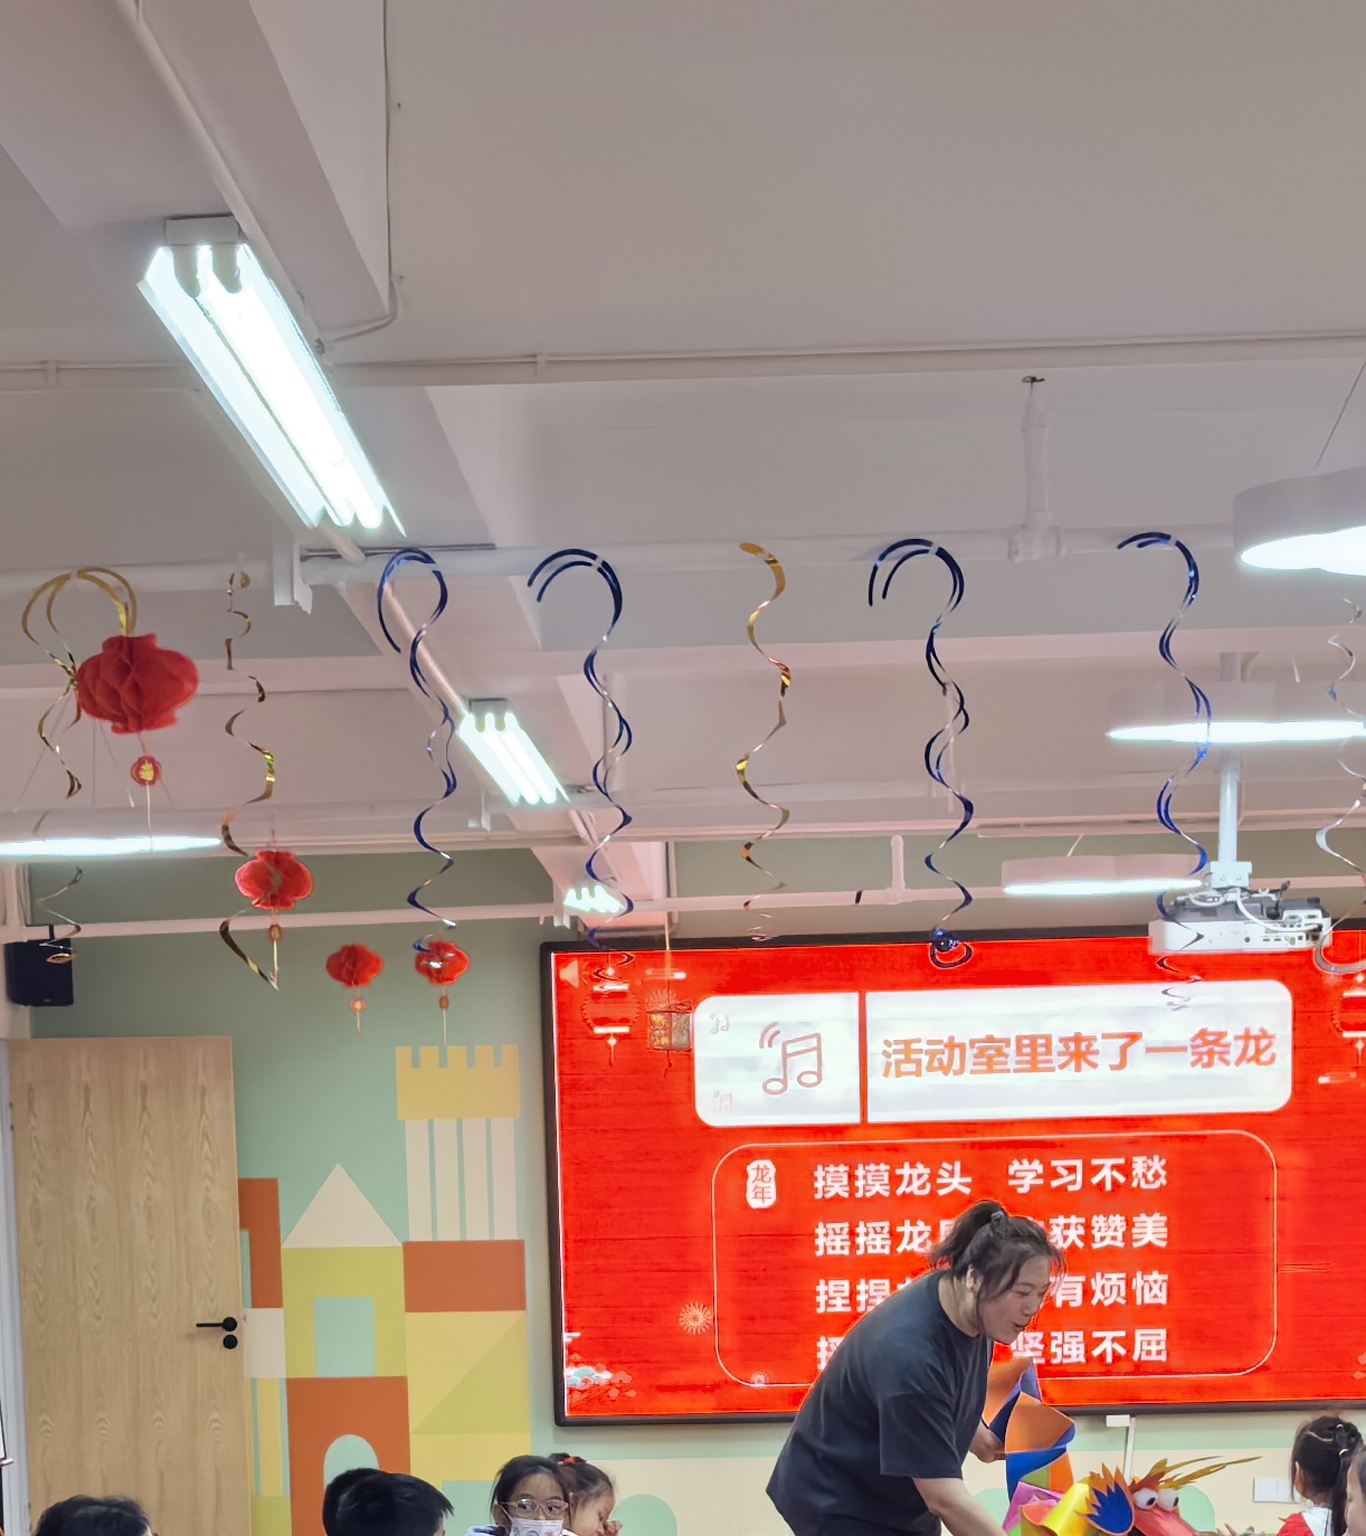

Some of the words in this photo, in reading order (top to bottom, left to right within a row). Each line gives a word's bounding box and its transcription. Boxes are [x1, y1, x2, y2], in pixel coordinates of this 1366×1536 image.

[881, 1026, 1277, 1079] 活动室里来了一条龙
[750, 1163, 772, 1205] 龙年
[813, 1160, 972, 1200] 摸摸龙头
[1007, 1154, 1168, 1195] 学习不愁
[1029, 1212, 1169, 1250] 获赞美
[815, 1277, 907, 1314] 捏捏
[1010, 1327, 1169, 1366] 坚强不屈
